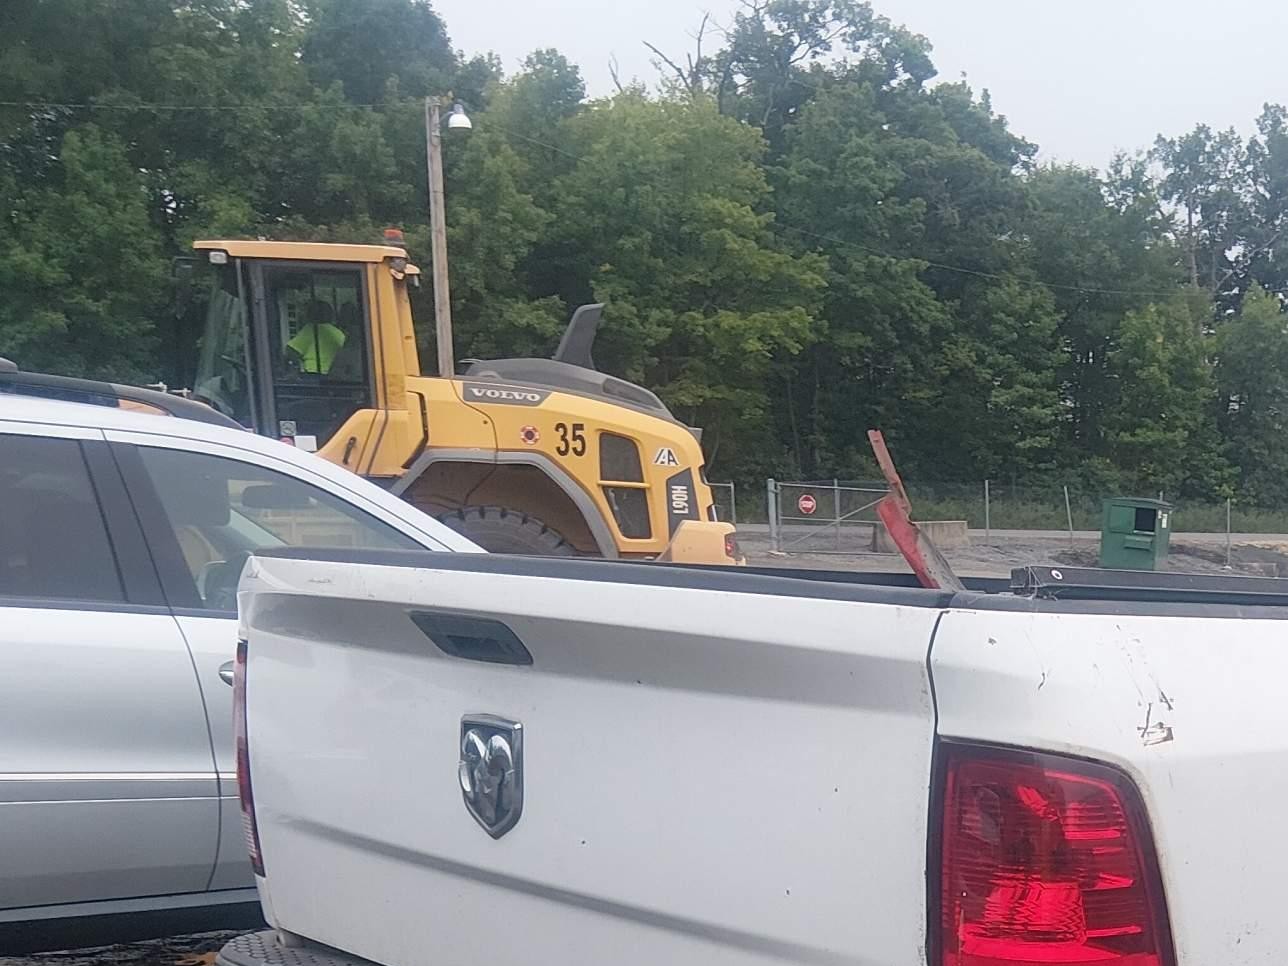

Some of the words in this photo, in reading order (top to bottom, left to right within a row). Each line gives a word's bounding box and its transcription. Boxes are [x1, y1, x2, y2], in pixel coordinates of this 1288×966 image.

[470, 387, 541, 402] VOLVO
[554, 423, 587, 457] 35
[671, 485, 689, 514] L90H
